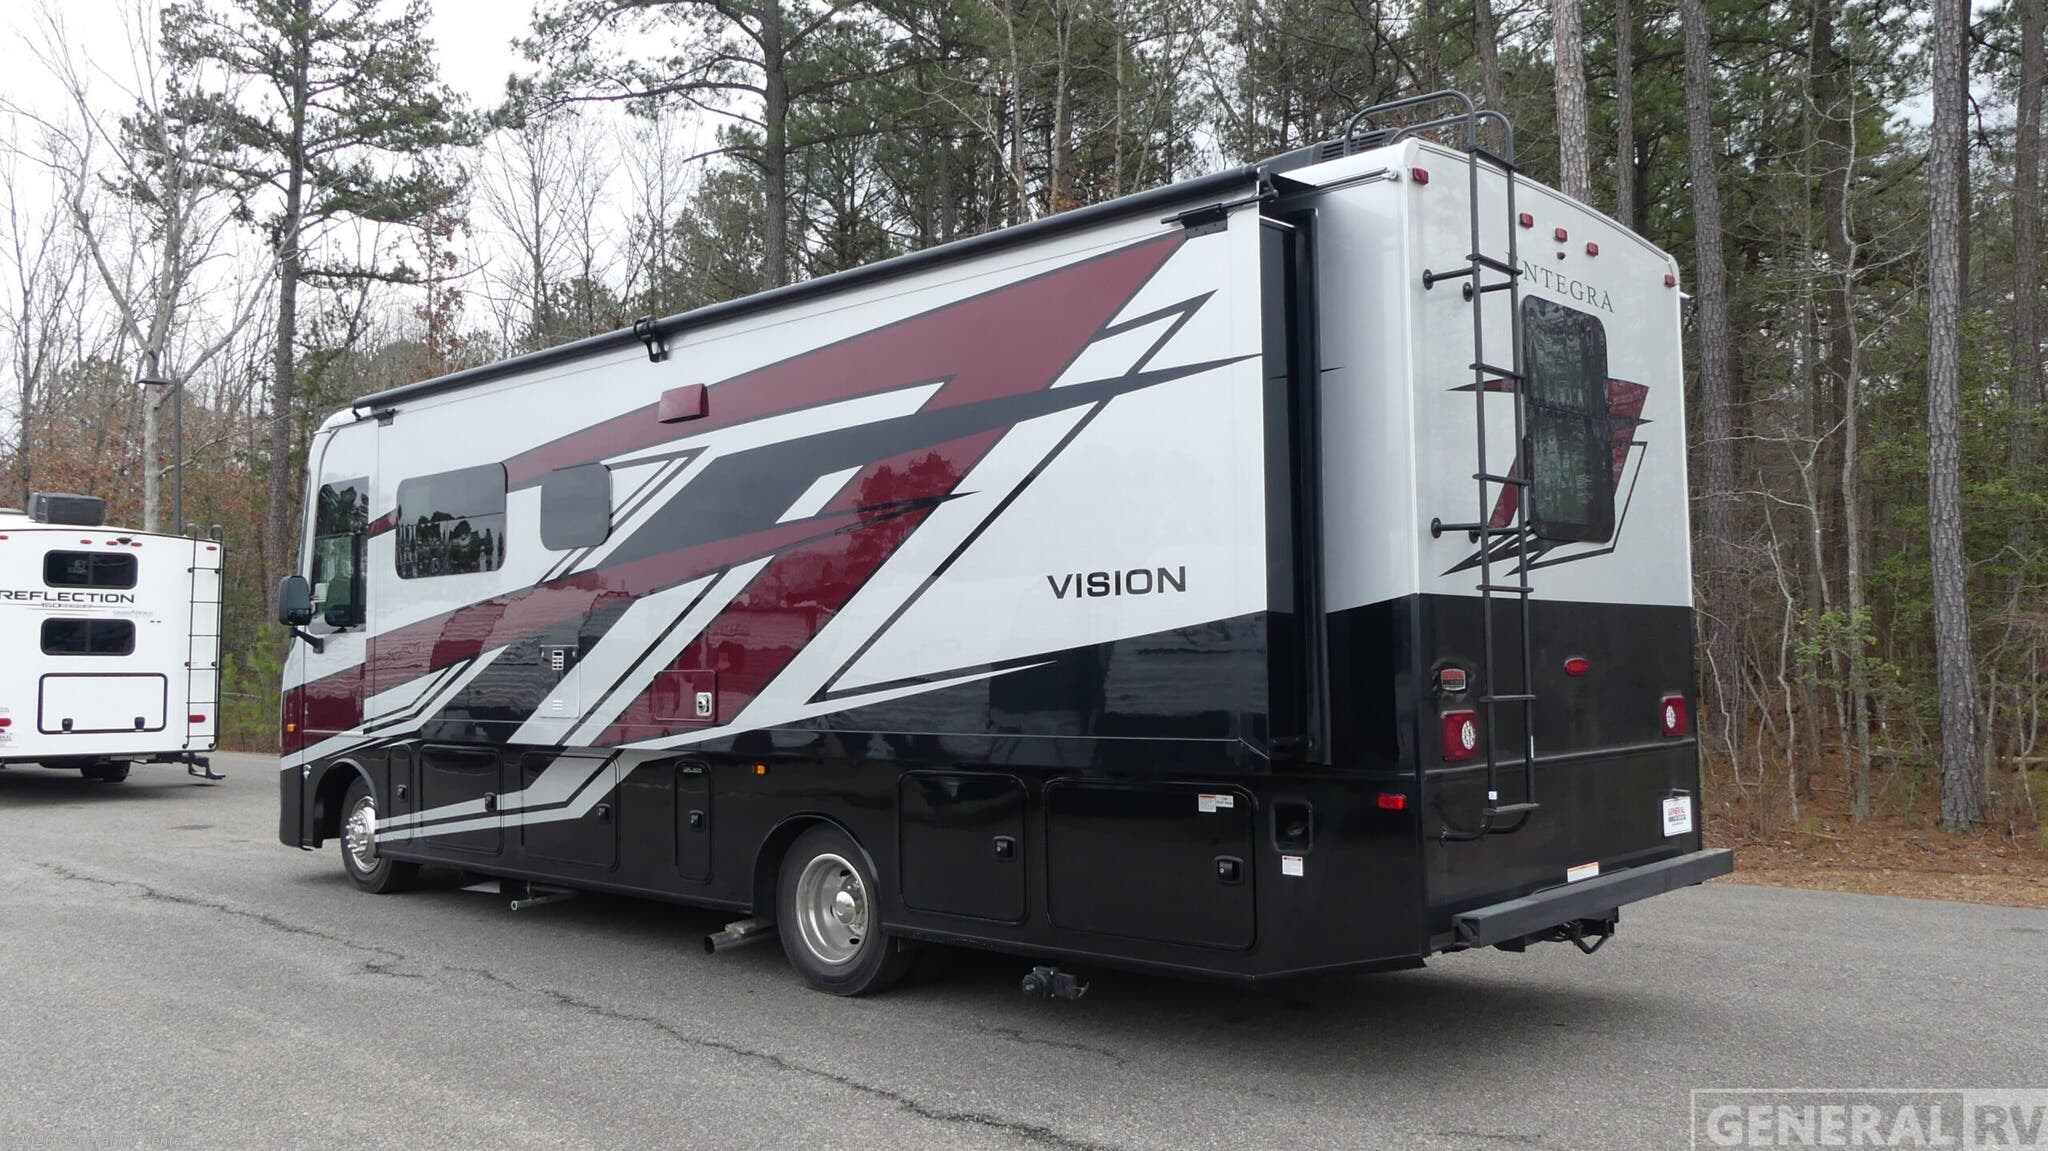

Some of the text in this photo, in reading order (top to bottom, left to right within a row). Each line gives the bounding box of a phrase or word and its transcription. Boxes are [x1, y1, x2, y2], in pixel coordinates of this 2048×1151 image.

[1506, 251, 1615, 313] NTEGRA
[0, 590, 135, 604] REFLECTION
[1047, 566, 1186, 599] VISION
